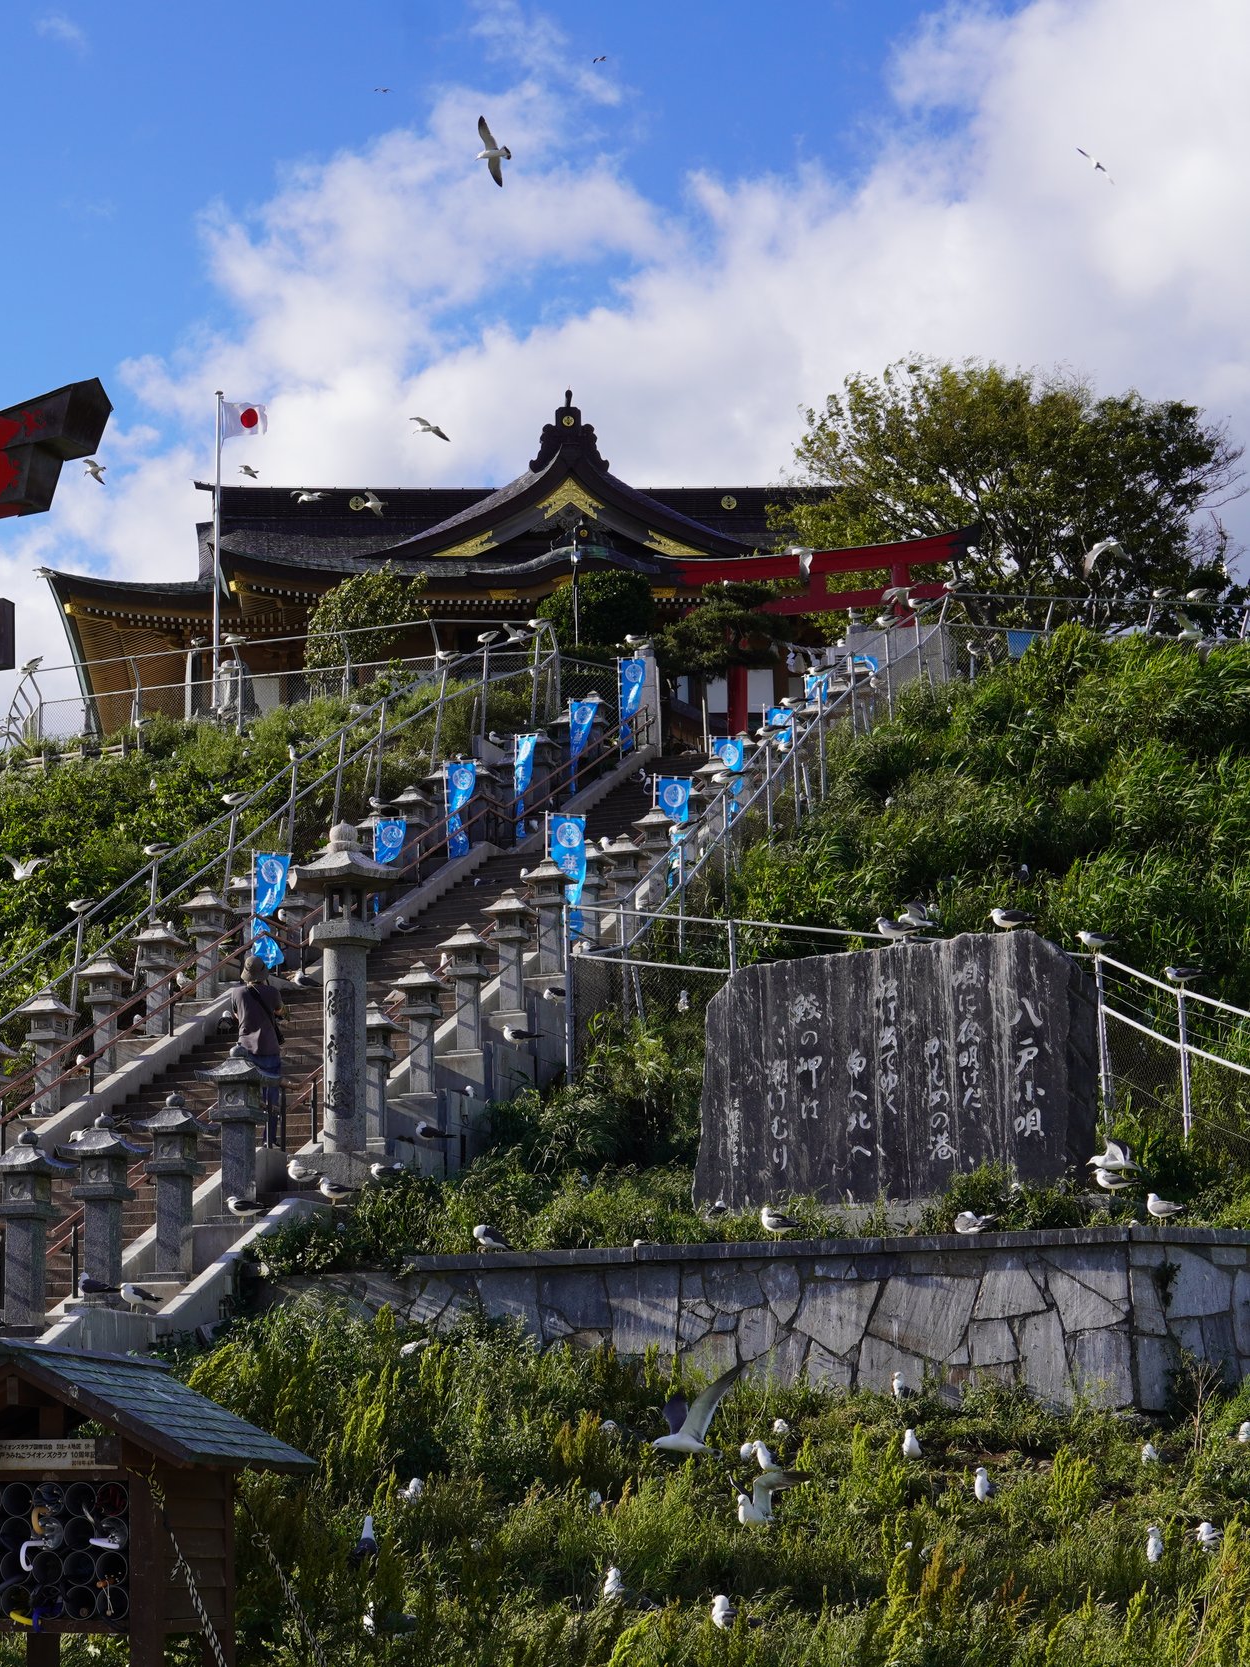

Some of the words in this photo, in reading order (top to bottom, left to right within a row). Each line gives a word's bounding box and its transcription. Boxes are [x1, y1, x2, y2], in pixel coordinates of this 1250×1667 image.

[846, 1048, 872, 1157] 南へ北へ
[1010, 996, 1046, 1138] 八戸小唄
